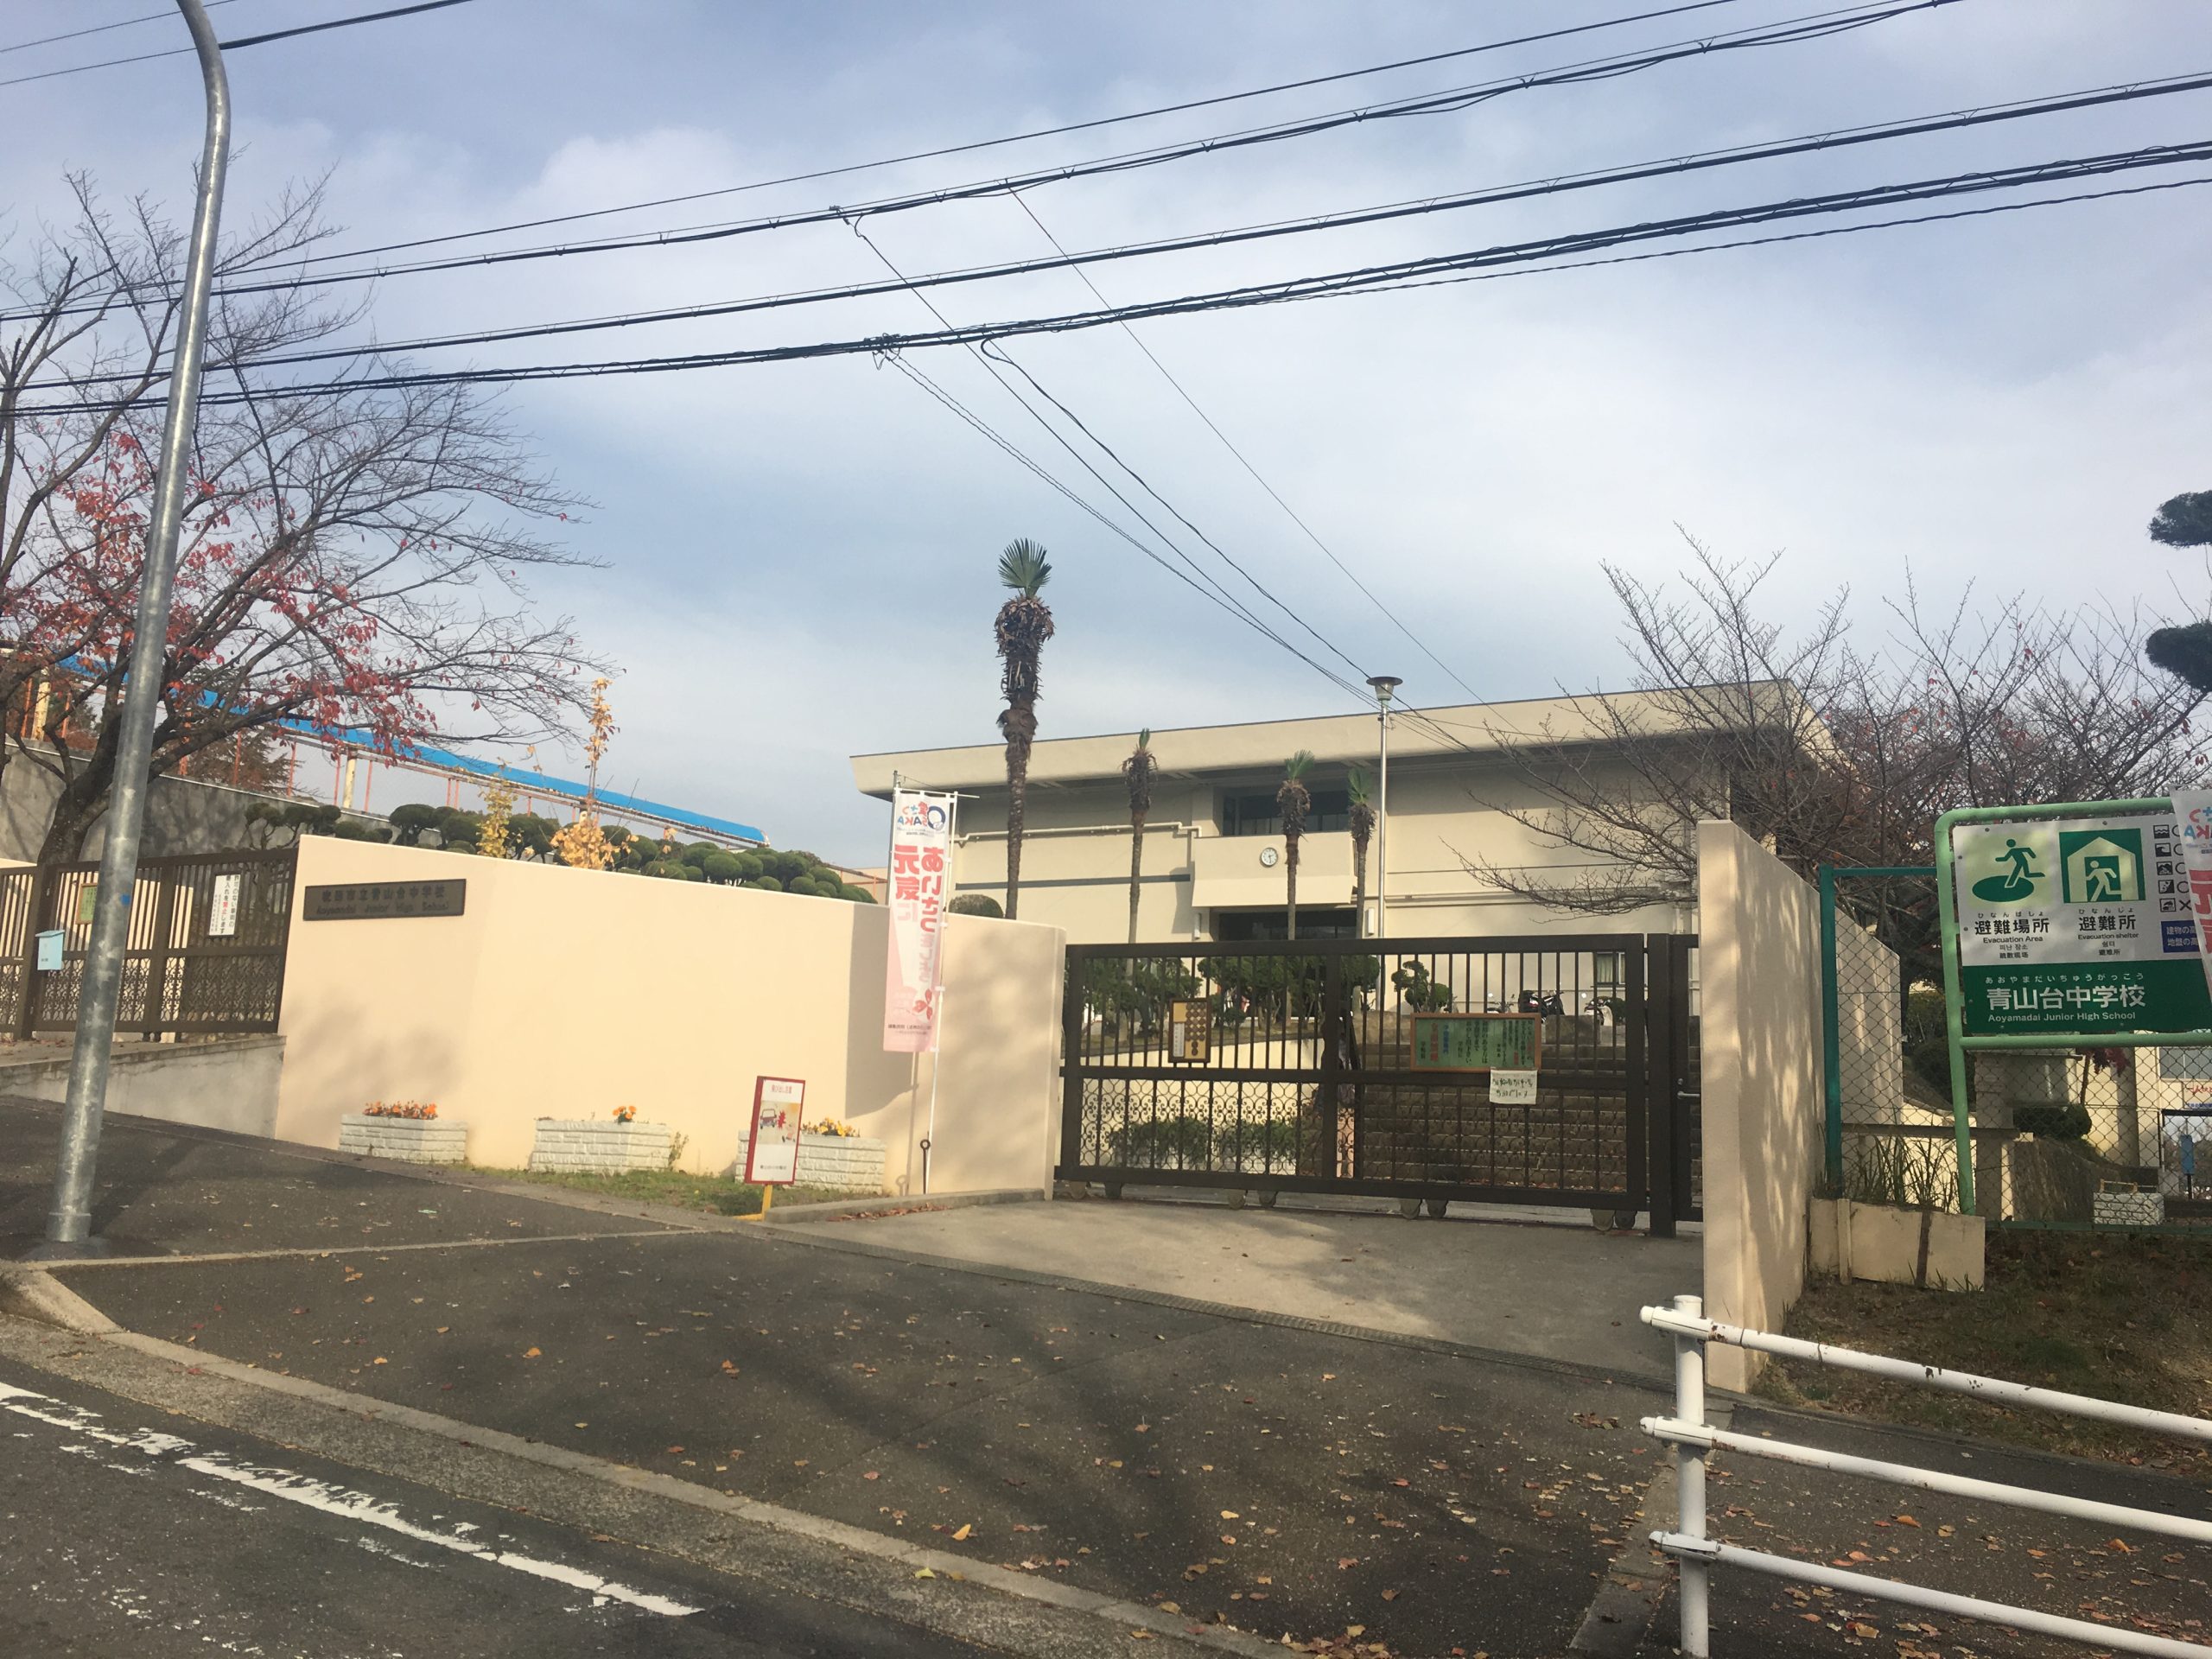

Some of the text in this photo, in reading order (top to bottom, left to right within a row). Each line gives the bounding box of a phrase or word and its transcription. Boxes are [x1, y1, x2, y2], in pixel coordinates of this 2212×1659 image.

[1974, 918, 2050, 935] 避難場所
[2078, 914, 2137, 931] 避難所
[1986, 984, 2146, 1011] 青山台中学校
[1988, 1011, 2136, 1023] Aoyamadai Junior High School
